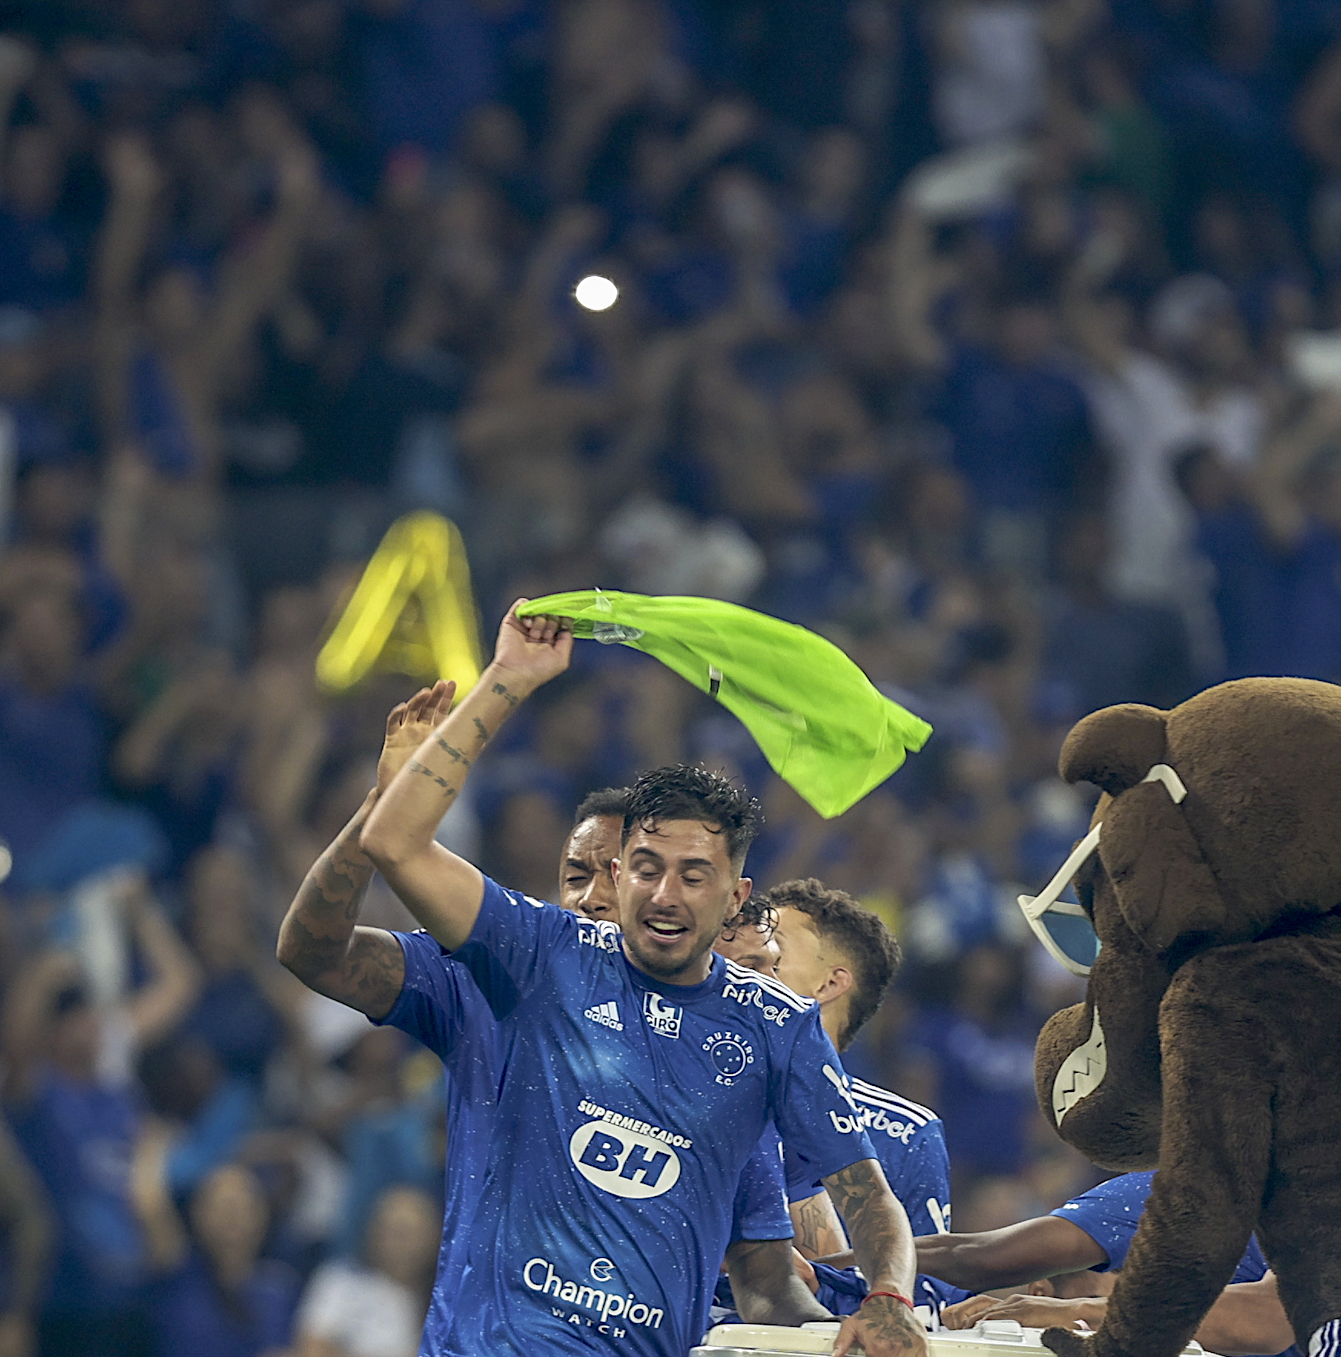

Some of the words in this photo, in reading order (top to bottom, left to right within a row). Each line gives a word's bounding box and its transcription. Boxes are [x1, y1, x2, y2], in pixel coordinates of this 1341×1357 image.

[584, 1009, 624, 1031] adidas
[702, 1031, 754, 1065] CRUZEIRO
[577, 1100, 693, 1149] SUPERMERCADOS
[578, 1130, 672, 1188] BH
[523, 1257, 664, 1329] Champion
[551, 1306, 626, 1339] WATCH
